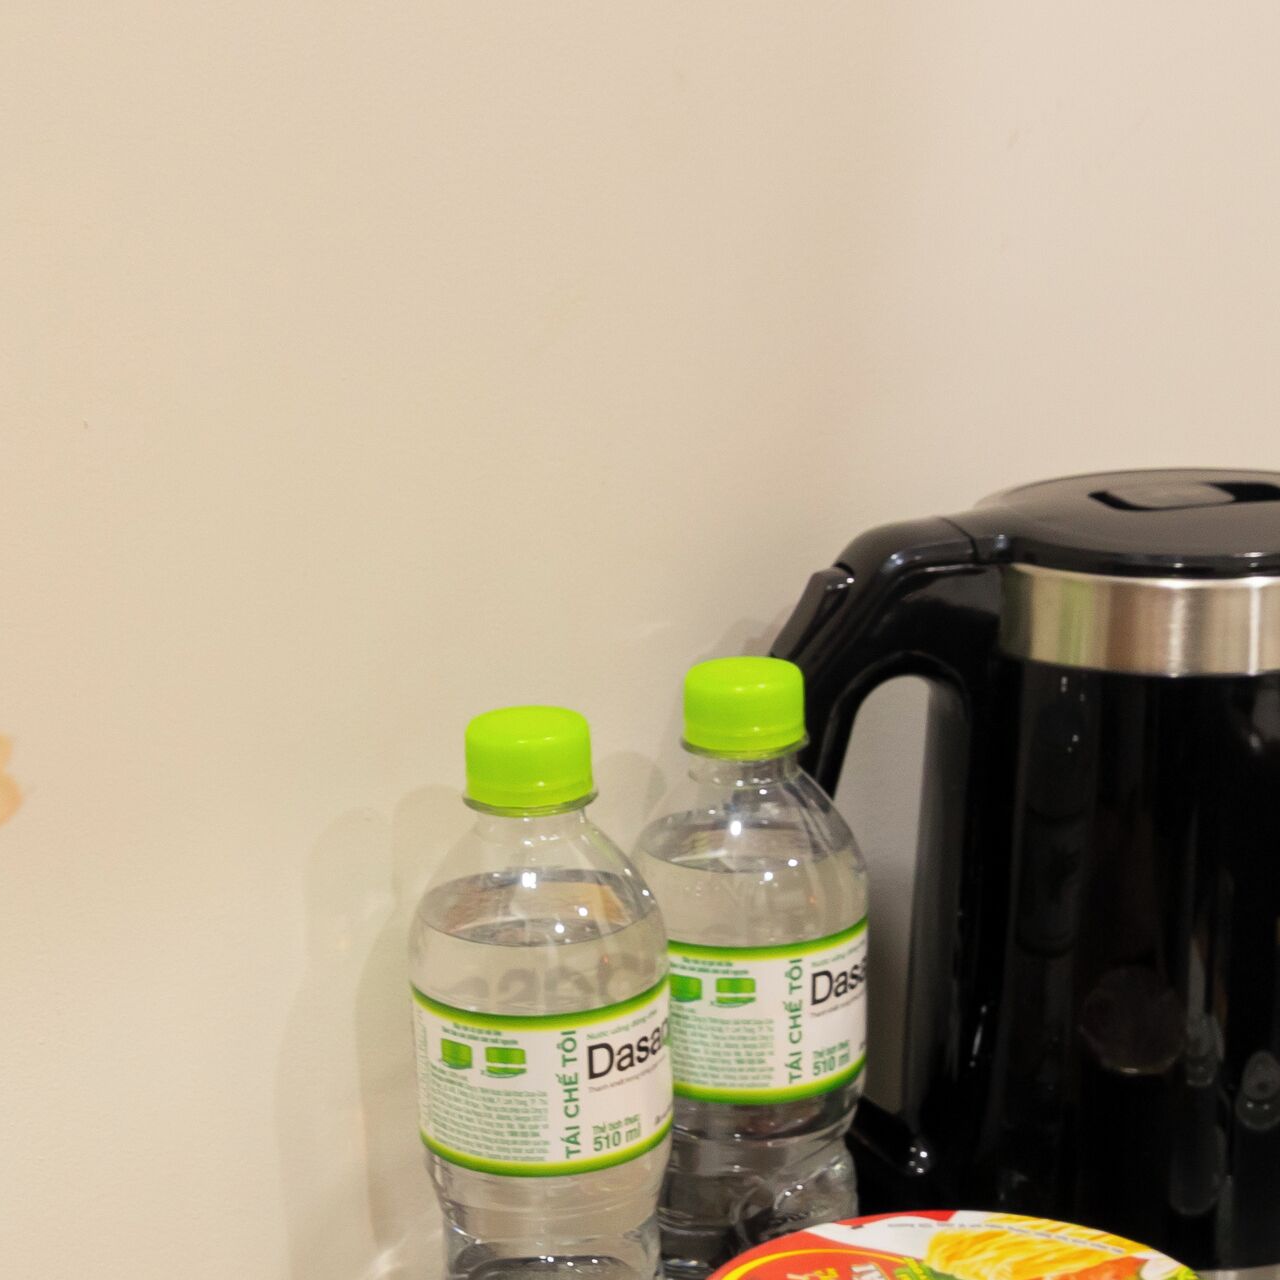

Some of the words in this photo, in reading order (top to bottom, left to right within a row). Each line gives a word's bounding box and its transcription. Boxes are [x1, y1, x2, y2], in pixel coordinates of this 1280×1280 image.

[784, 958, 802, 994] TÔI
[783, 1000, 802, 1044] CHẾ
[557, 1030, 578, 1068] TÔI
[812, 1055, 837, 1077] 510
[784, 1050, 802, 1084] TÁI
[556, 1073, 580, 1119] CHẾ
[561, 1125, 581, 1160] TÁI
[593, 1131, 621, 1152] 510
[625, 1123, 641, 1143] ml
